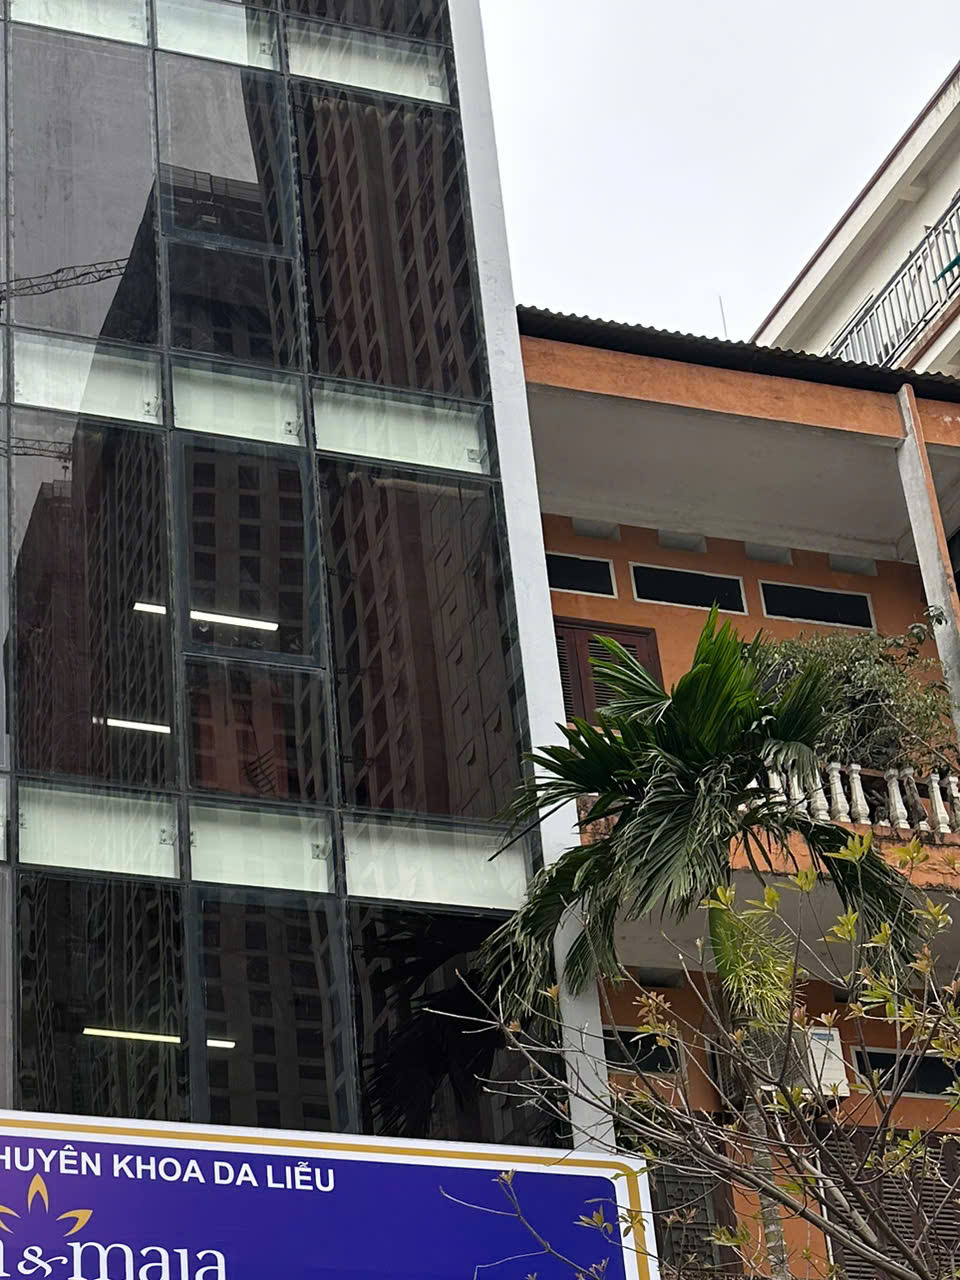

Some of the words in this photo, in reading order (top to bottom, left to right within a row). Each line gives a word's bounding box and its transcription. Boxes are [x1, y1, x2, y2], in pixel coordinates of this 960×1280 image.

[112, 1154, 206, 1184] KHOA
[214, 1161, 259, 1188] DA
[266, 1160, 335, 1193] LIỄU
